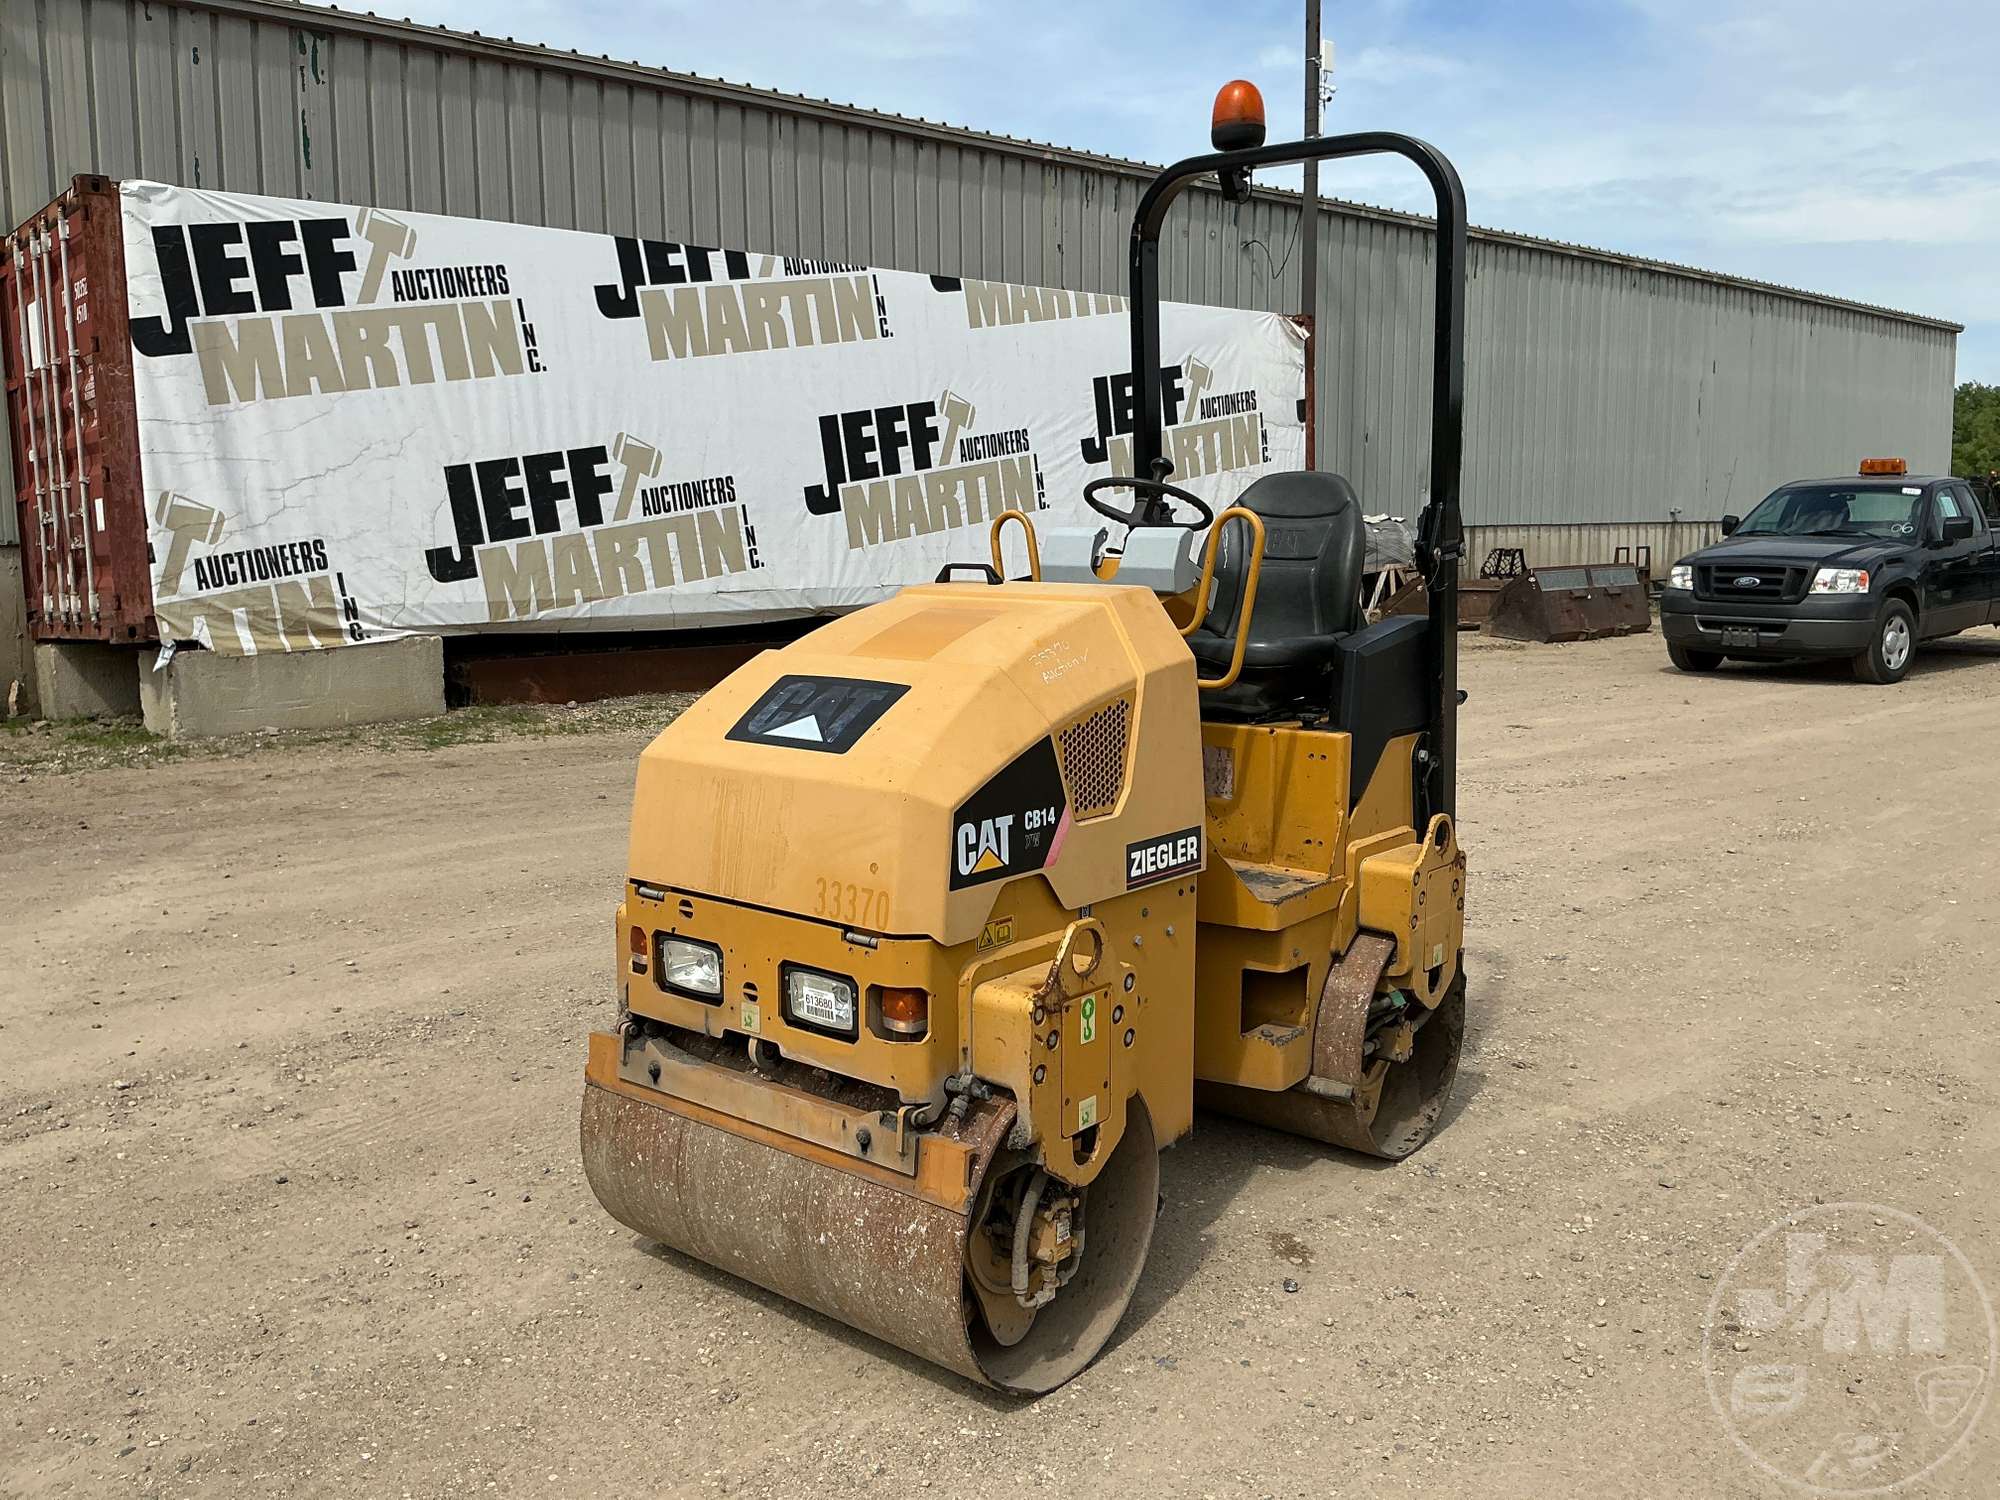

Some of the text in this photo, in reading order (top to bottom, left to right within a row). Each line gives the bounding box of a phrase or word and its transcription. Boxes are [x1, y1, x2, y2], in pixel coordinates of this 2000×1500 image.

[131, 217, 357, 357] JEFF
[392, 264, 511, 302] AUCTIONEERS
[872, 274, 894, 338] INC.
[517, 298, 547, 373] INC.
[640, 275, 877, 361] MARTIN
[192, 300, 525, 406] MARTIN
[1081, 365, 1185, 464] JEF
[1200, 390, 1257, 420] AUCTIONEERS
[804, 401, 939, 516] JEFF
[960, 429, 1030, 463] AUCTIONEERS
[1260, 412, 1272, 463] INC.
[641, 475, 736, 517] AUCTIONEERS
[842, 455, 1036, 550] MARTIN
[1033, 454, 1050, 510] INC.
[425, 445, 614, 583] JEFF
[742, 504, 765, 569] INC.
[195, 539, 329, 591] AUCTIONEERS
[478, 506, 746, 622] MARTIN
[747, 681, 889, 744] CAT
[957, 814, 1013, 876] CAT
[1024, 806, 1056, 830] CB14
[1130, 836, 1198, 878] ZIEGLER
[815, 876, 890, 931] 33370
[805, 993, 833, 1010] 613680
